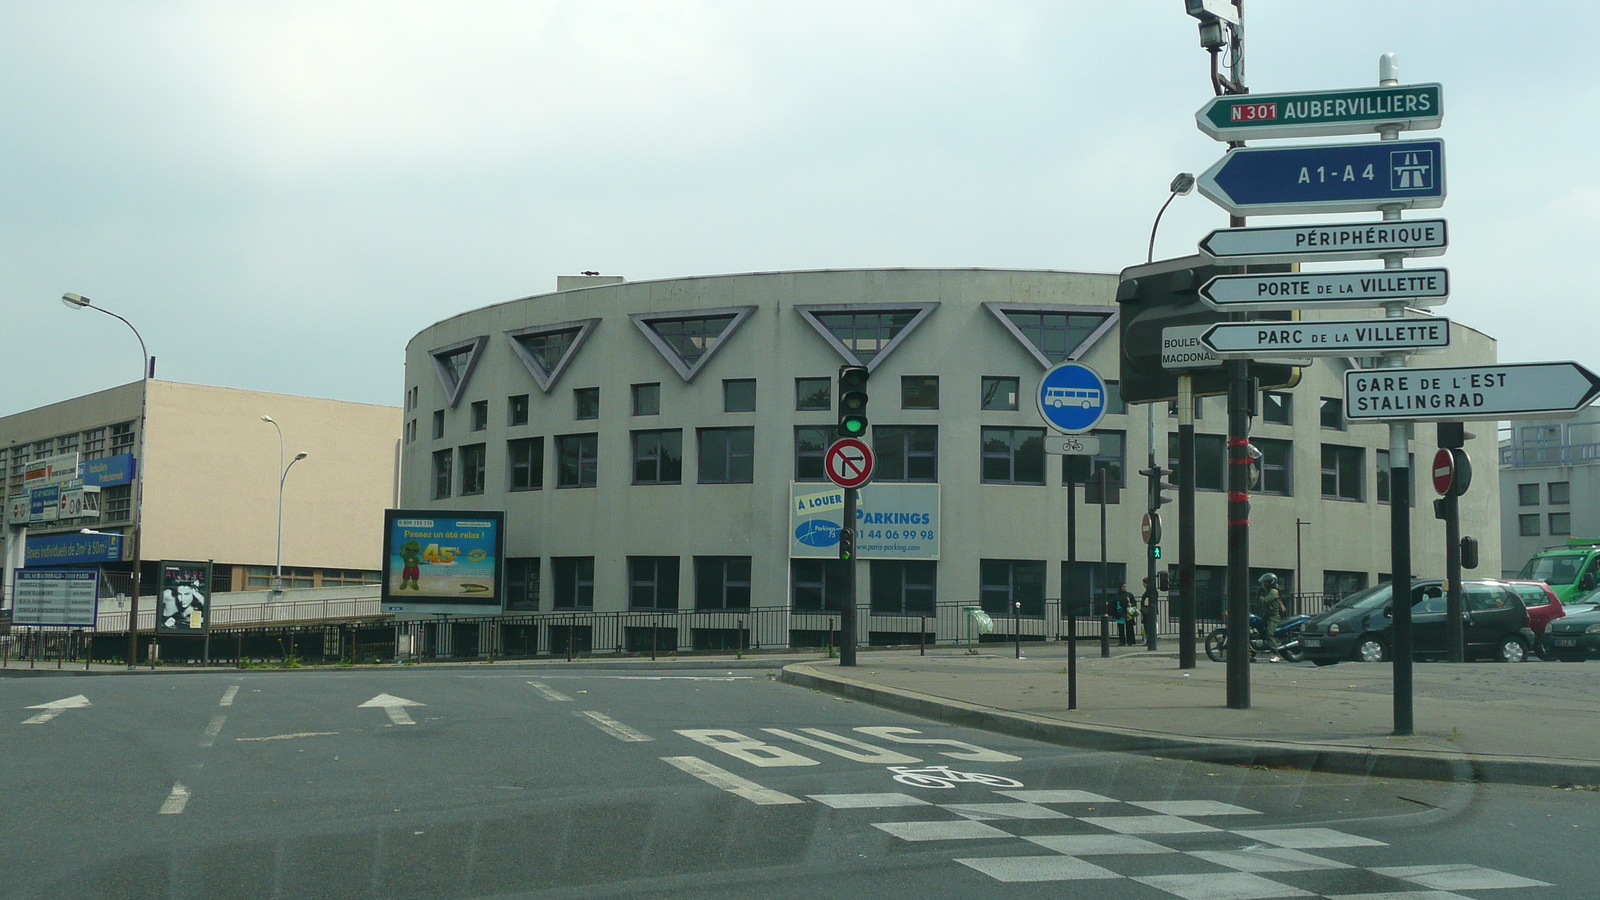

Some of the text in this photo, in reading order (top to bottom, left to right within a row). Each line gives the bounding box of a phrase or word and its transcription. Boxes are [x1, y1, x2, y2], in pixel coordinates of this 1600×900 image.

[1232, 94, 1431, 120] N 301 AUBERVILLIERS
[1296, 226, 1435, 246] PÉRIPHÉRIQUE
[1258, 276, 1437, 296] PORTE DE LA VILLETTE
[1258, 326, 1439, 344] PARC DE LA VILLETTE
[1164, 338, 1200, 349] BOULEV
[1162, 352, 1216, 364] MACDONAL
[1356, 377, 1408, 392] GARE
[1420, 378, 1440, 390] DE
[1358, 393, 1484, 410] STALINGRAD
[798, 499, 806, 510] À
[809, 494, 842, 508] LOUER
[404, 530, 431, 538] Passez
[868, 530, 882, 539] 44
[885, 530, 899, 540] 06
[903, 530, 917, 540] 99
[920, 530, 934, 540] 98
[27, 546, 40, 558] Boxes
[41, 544, 68, 558] individuels
[68, 545, 75, 556] de
[166, 570, 204, 579] ALLURE
[673, 726, 1023, 767] BUS
